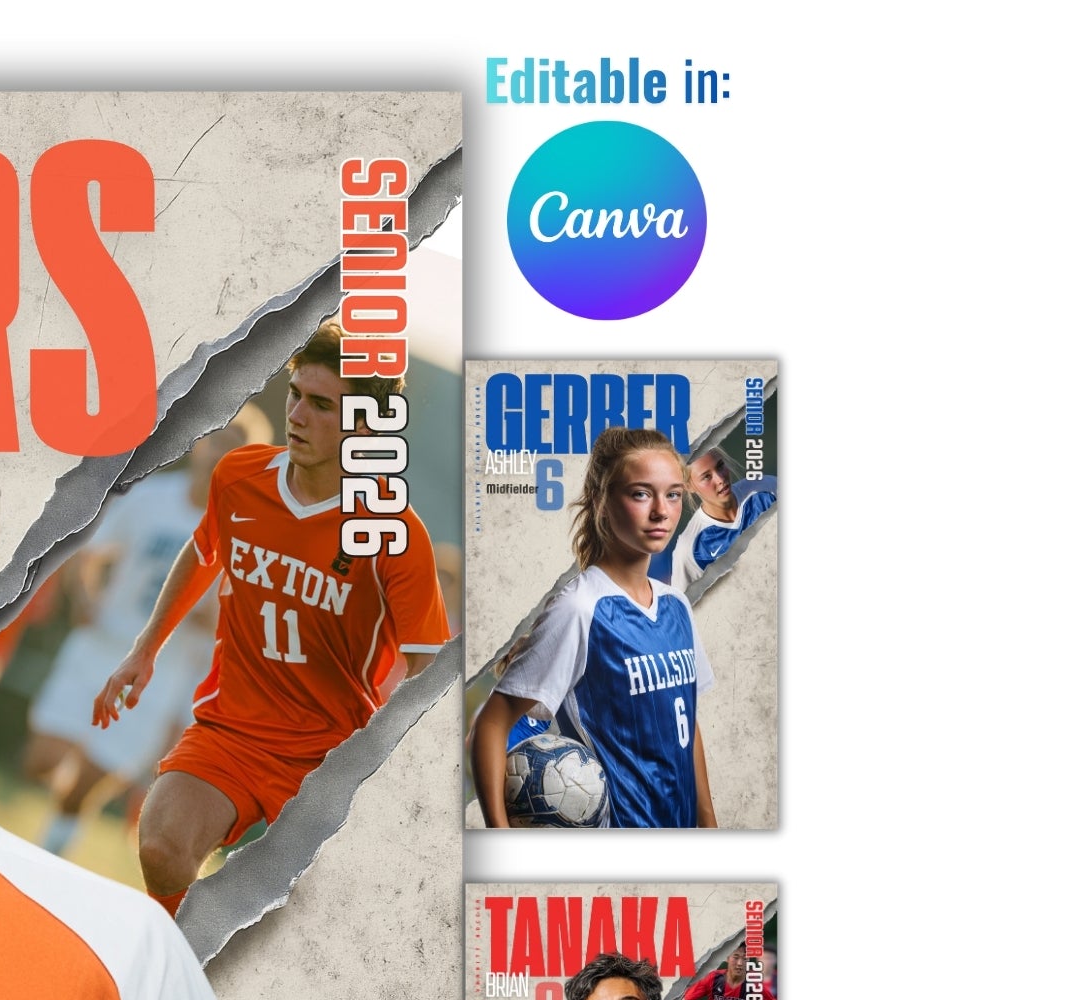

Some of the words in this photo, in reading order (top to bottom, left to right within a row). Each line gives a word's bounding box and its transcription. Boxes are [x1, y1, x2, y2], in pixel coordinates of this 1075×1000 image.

[339, 157, 410, 380] SENIOR
[485, 372, 692, 455] GERBER
[744, 376, 765, 436] SENIOR
[340, 393, 410, 559] 2026
[484, 448, 538, 475] ASHLEY
[535, 458, 565, 511] 6
[745, 438, 764, 481] 2026
[486, 483, 539, 496] Midfielder
[230, 536, 354, 616] EXTON
[259, 600, 308, 664] 11
[674, 696, 690, 750] 6
[484, 896, 696, 978] TANAKA
[744, 899, 765, 958] SENIOR
[485, 971, 530, 998] BRIAN
